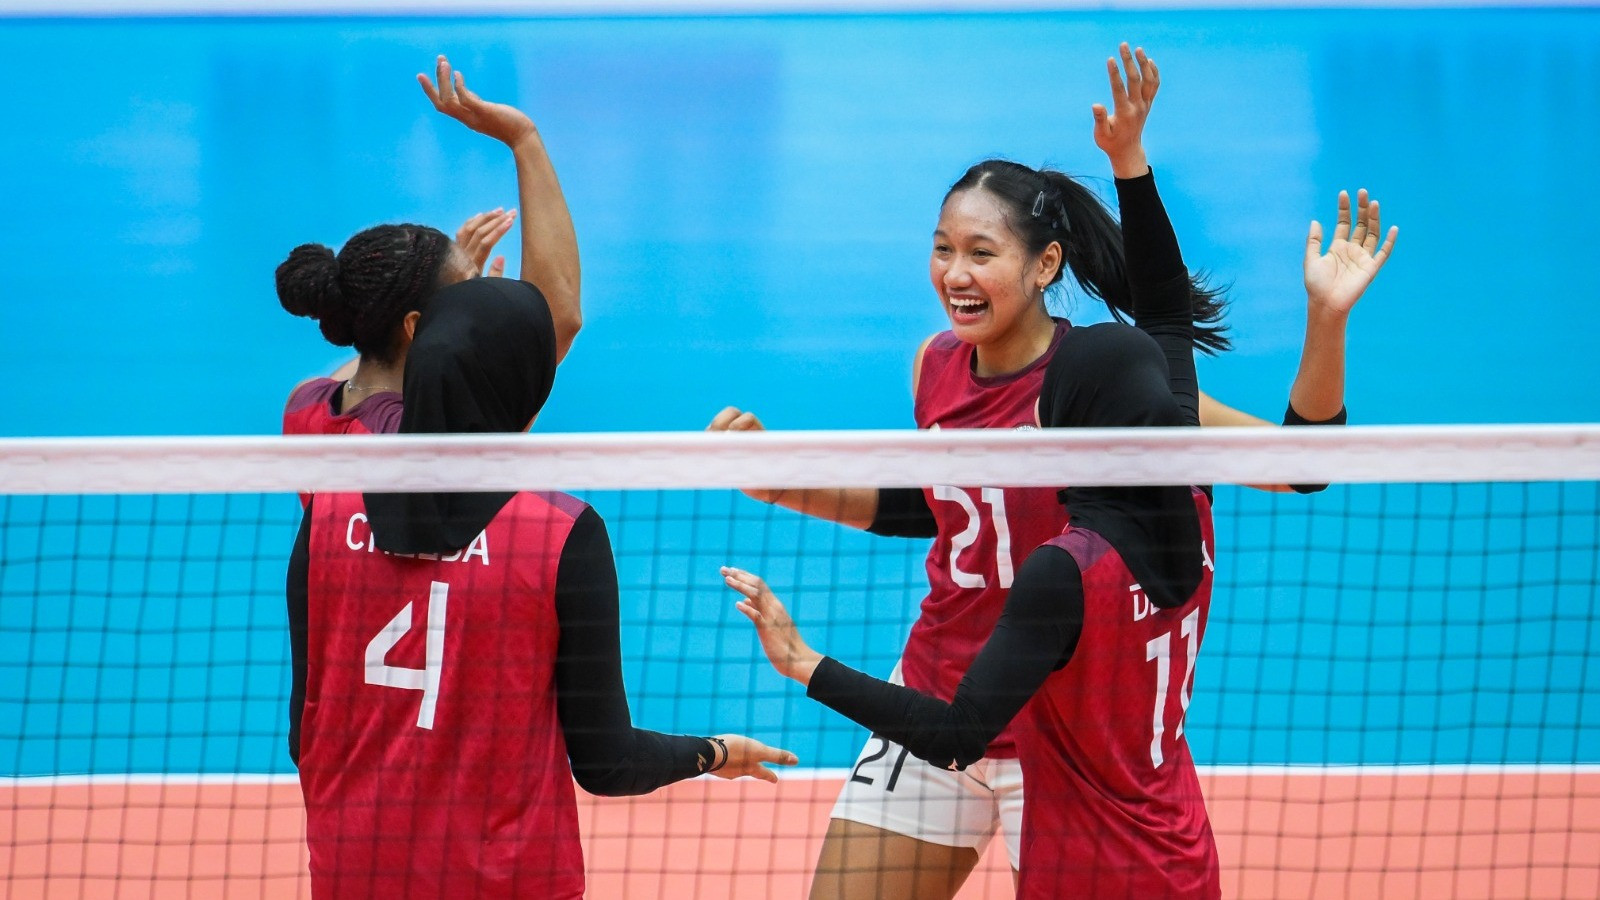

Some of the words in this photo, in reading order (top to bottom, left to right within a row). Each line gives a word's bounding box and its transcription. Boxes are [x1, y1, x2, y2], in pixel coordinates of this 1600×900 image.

[933, 485, 1014, 588] 21
[365, 581, 449, 730] 4
[1146, 606, 1199, 769] 11
[850, 732, 910, 792] 21
